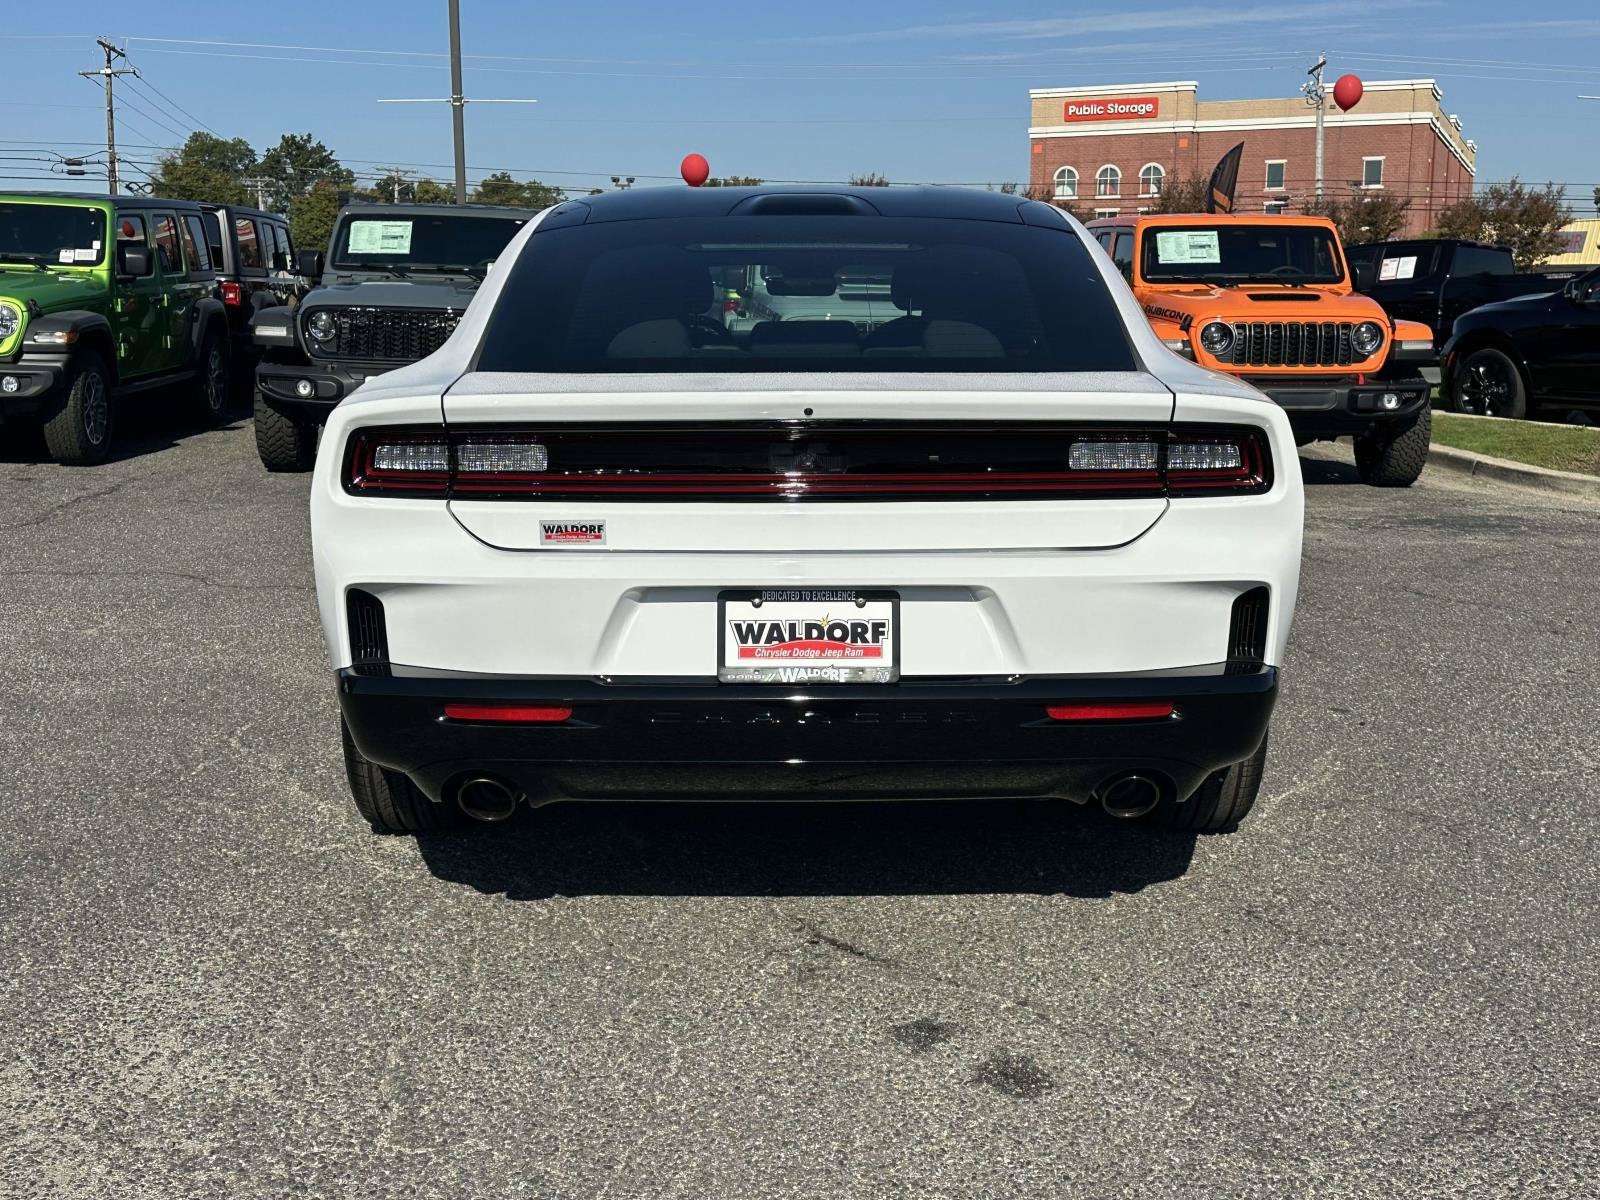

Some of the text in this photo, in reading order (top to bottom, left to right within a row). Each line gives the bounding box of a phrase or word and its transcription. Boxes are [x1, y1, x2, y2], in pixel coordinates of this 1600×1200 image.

[1068, 105, 1104, 115] Public
[543, 524, 604, 534] WALDORF
[762, 591, 856, 601] DEDICATED TO EXCELLENCE
[733, 621, 887, 645] WALDORF
[755, 648, 864, 659] Chrysler Dodge Jeep Ram
[779, 667, 850, 682] WALDORF
